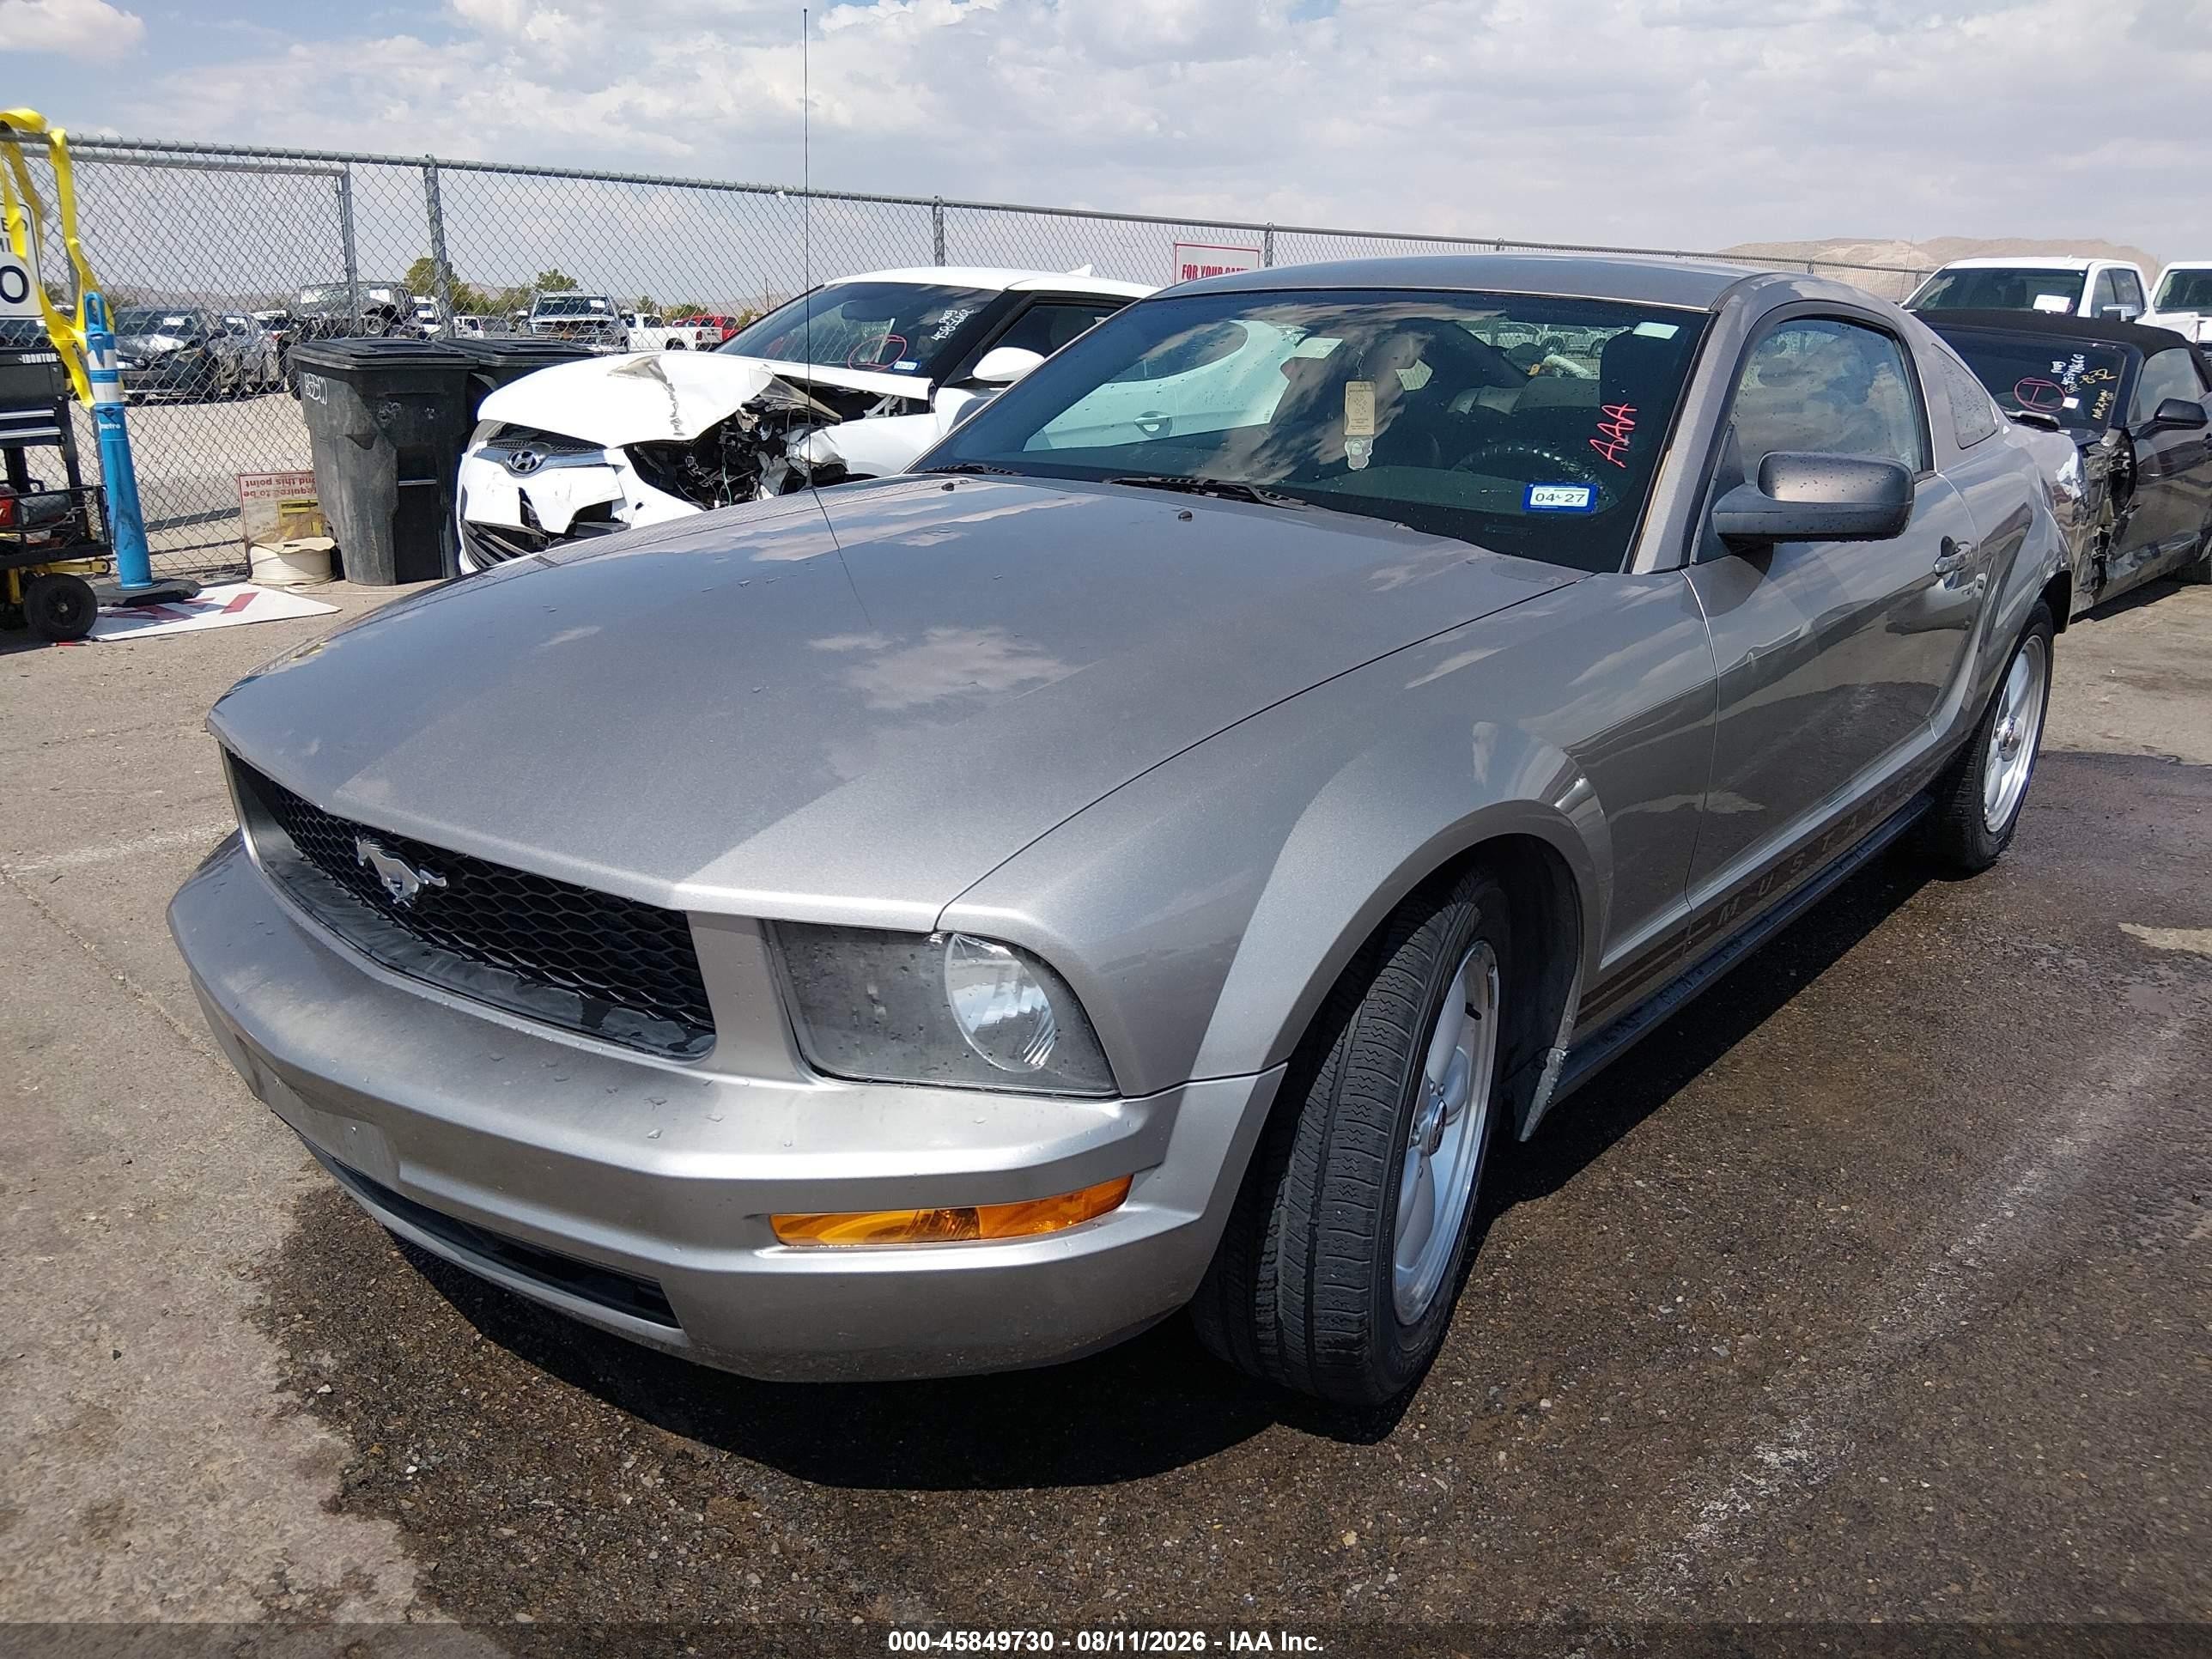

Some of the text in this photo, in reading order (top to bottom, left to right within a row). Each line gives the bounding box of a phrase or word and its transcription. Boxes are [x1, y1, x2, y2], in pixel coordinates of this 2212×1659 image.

[1182, 264, 1199, 280] FOR
[21, 353, 58, 364] IRONTON
[1589, 403, 1638, 469] AAA
[246, 478, 272, 488] point
[276, 477, 295, 486] this
[1535, 493, 1585, 502] 04 27
